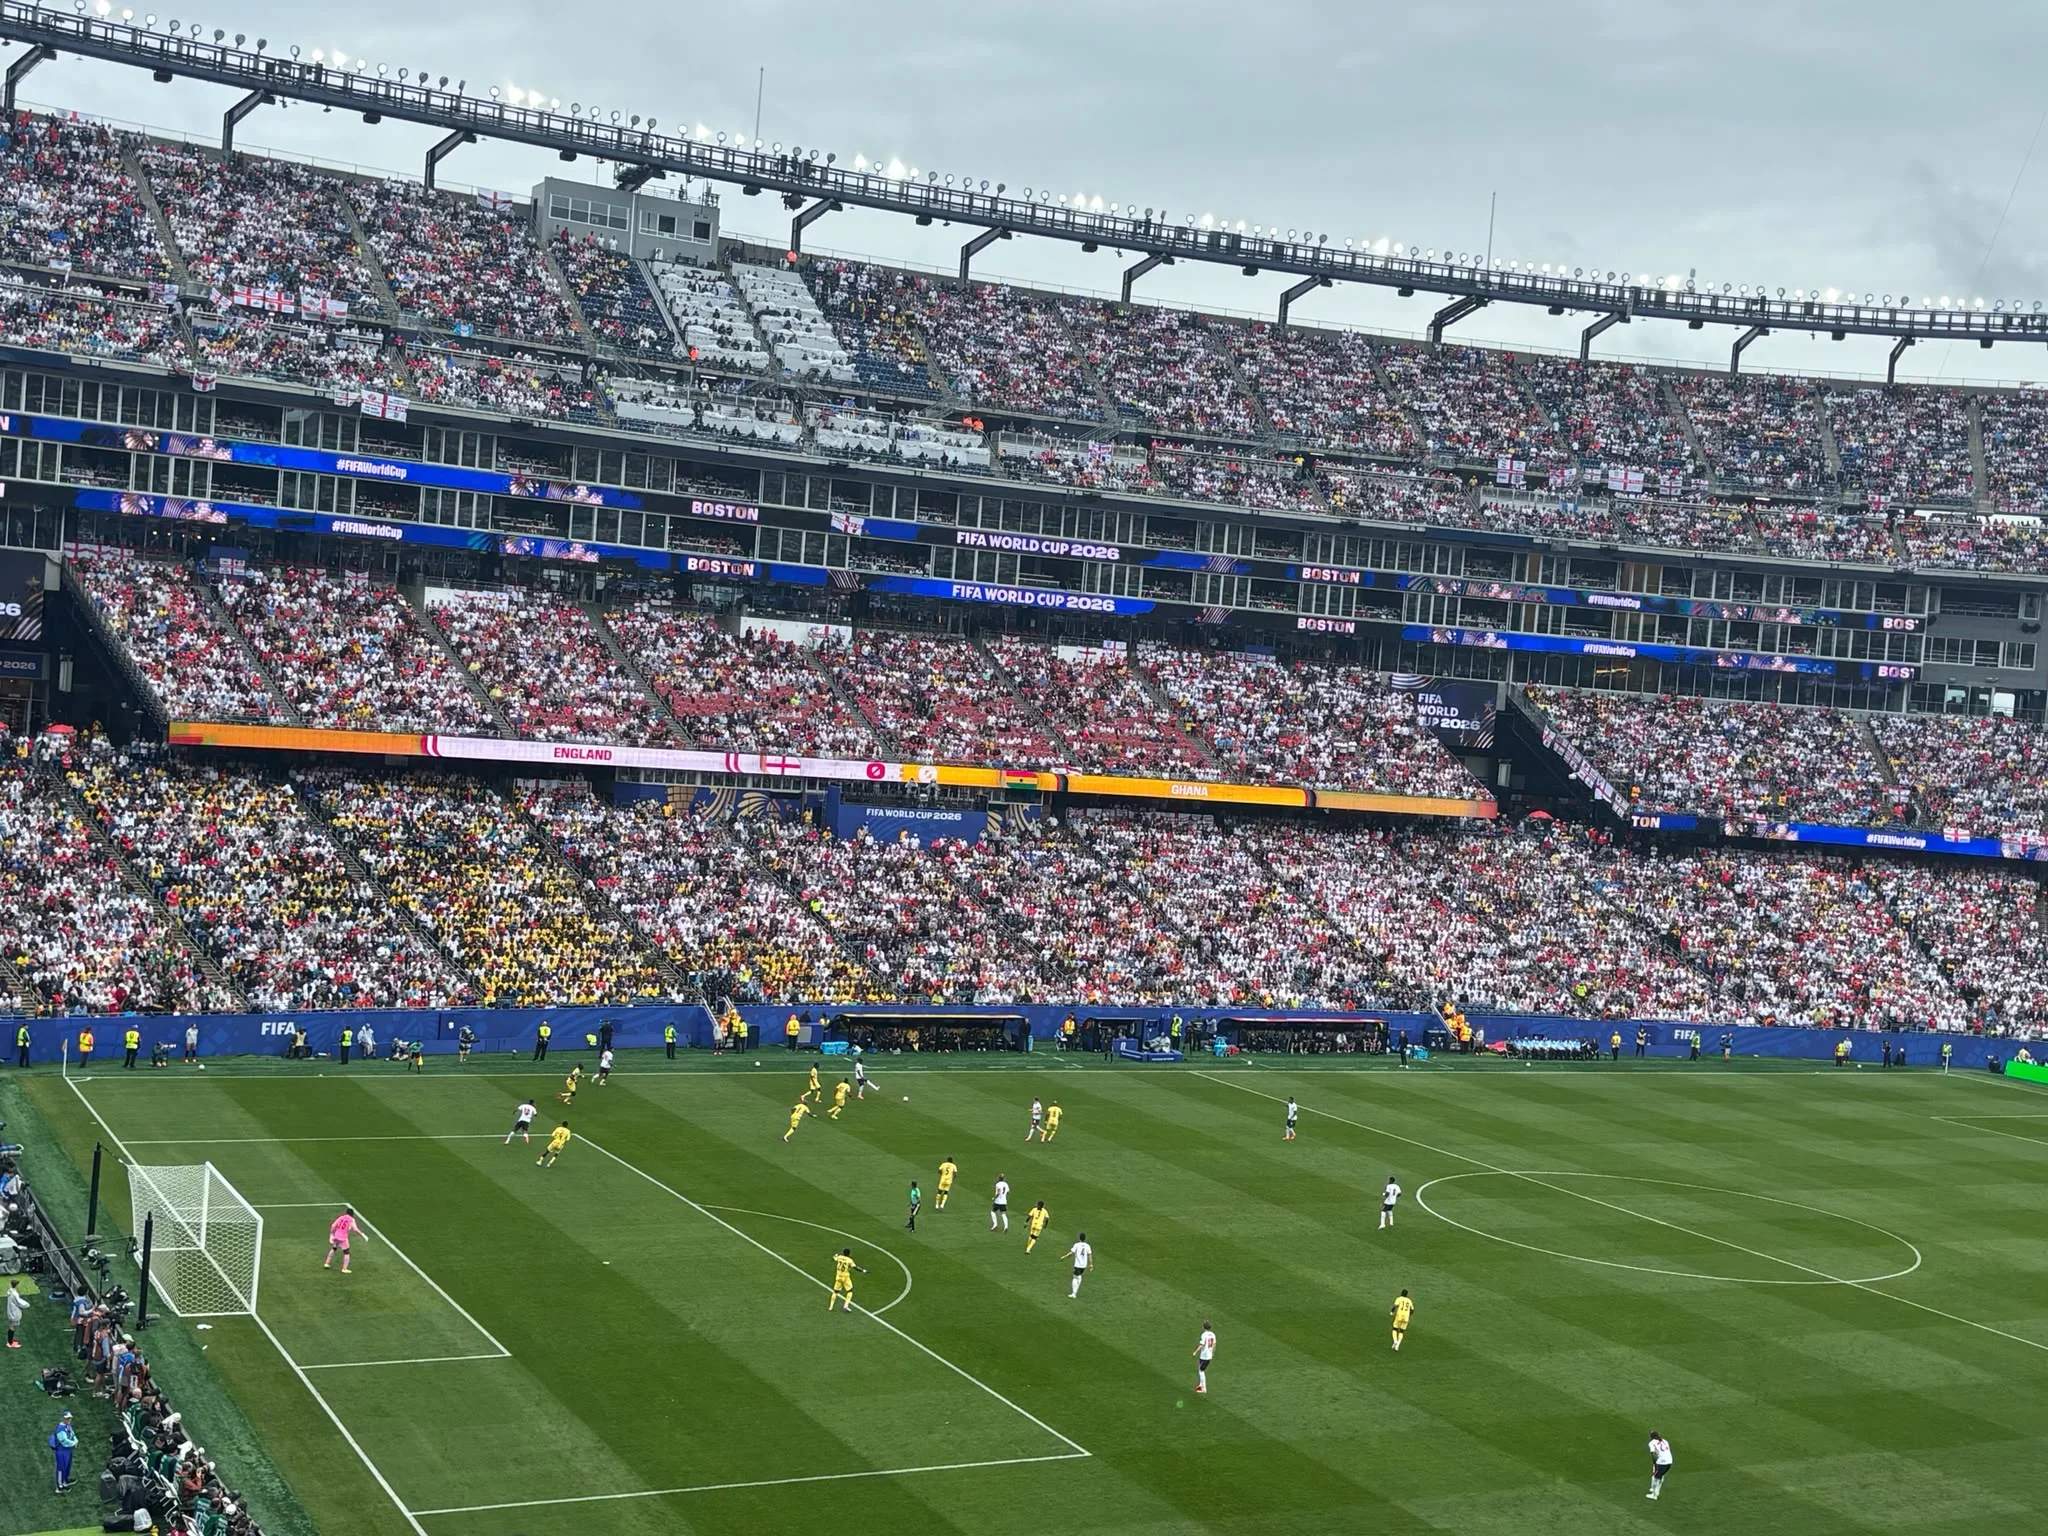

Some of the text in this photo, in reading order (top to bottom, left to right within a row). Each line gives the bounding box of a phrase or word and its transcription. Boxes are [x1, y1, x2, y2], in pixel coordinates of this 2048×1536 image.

[336, 459, 407, 480] #FIFAWorldCup
[691, 501, 759, 521] BOSTON
[332, 520, 403, 540] #FIFAWorldCup
[956, 531, 1120, 560] FIFA WORLD CUP 2026
[687, 557, 755, 577] BOSTON
[1302, 567, 1360, 584] BOSTON
[952, 584, 1116, 612] FIFA WORLD CUP 2026
[1588, 595, 1641, 610] #FIFAWorldCup
[1297, 617, 1355, 634] BOSTON
[1883, 617, 1919, 631] BOS
[1583, 643, 1636, 658] #FIFAWorldCup
[3, 661, 36, 670] 2026
[1418, 693, 1443, 704] FIFA
[1417, 704, 1459, 717] WORLD
[1440, 718, 1480, 731] 2026
[554, 747, 612, 761] ENGLAND
[1171, 784, 1208, 797] GHANA
[866, 808, 962, 821] FIFA WORLD CUP 2026
[1631, 815, 1660, 829] TON
[1866, 833, 1927, 849] #FIFAWorldCup
[261, 1021, 296, 1035] FIFA
